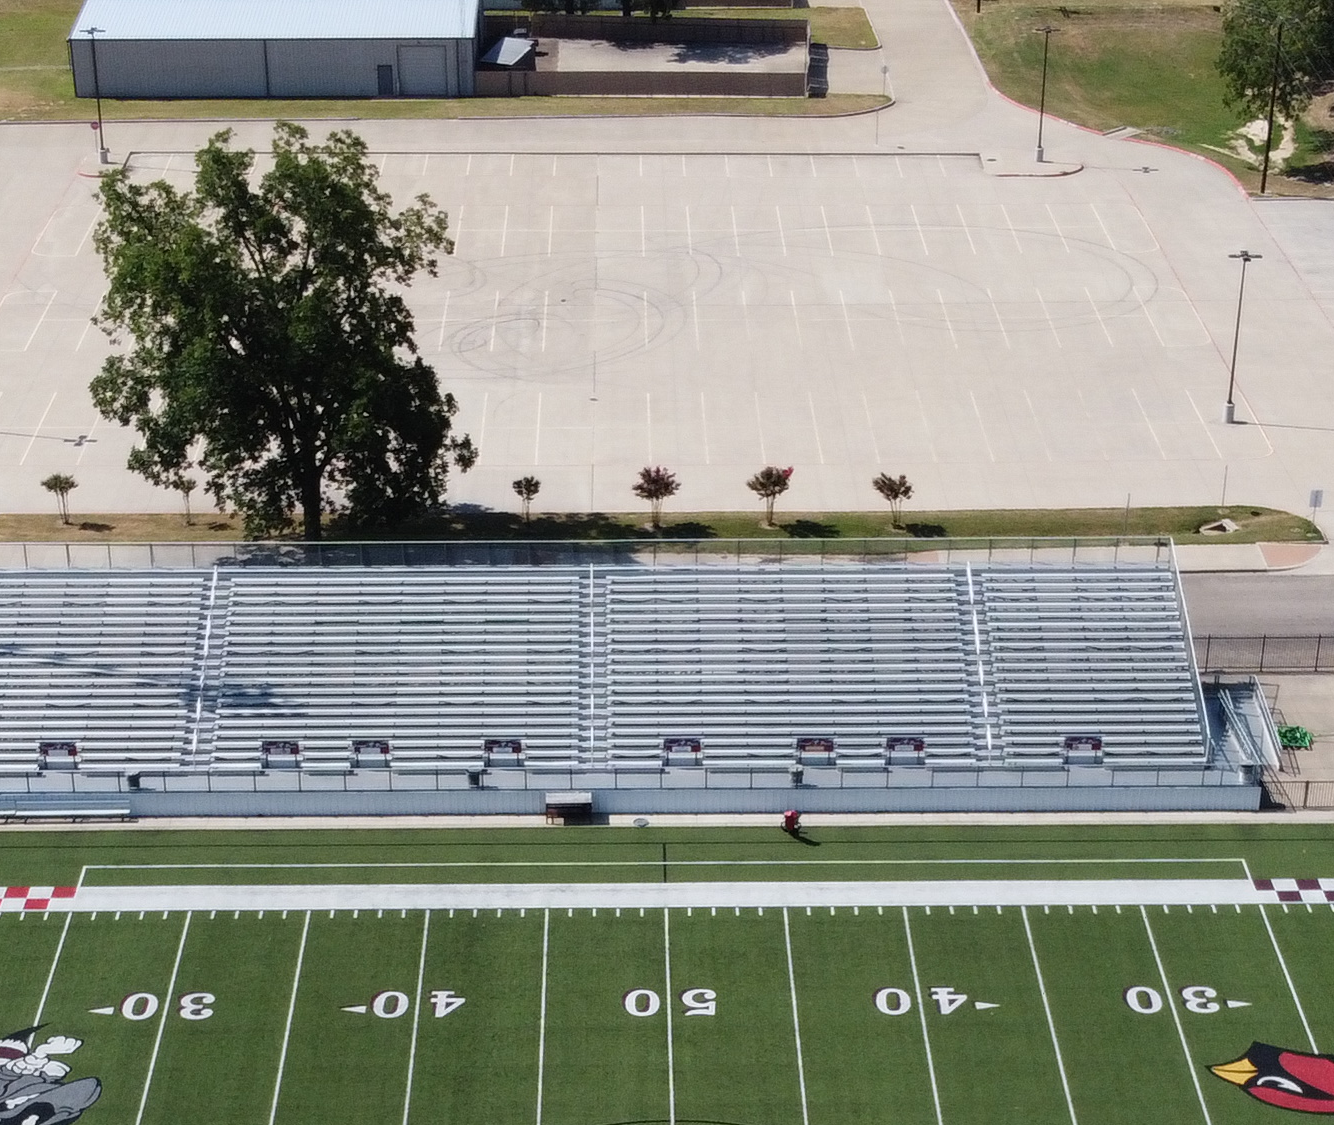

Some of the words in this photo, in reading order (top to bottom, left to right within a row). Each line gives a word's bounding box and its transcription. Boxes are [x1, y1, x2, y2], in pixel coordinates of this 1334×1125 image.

[120, 991, 216, 1021] 30
[371, 989, 466, 1019] 40
[624, 988, 717, 1017] 50
[874, 987, 969, 1016] 40
[1125, 985, 1220, 1014] 30
